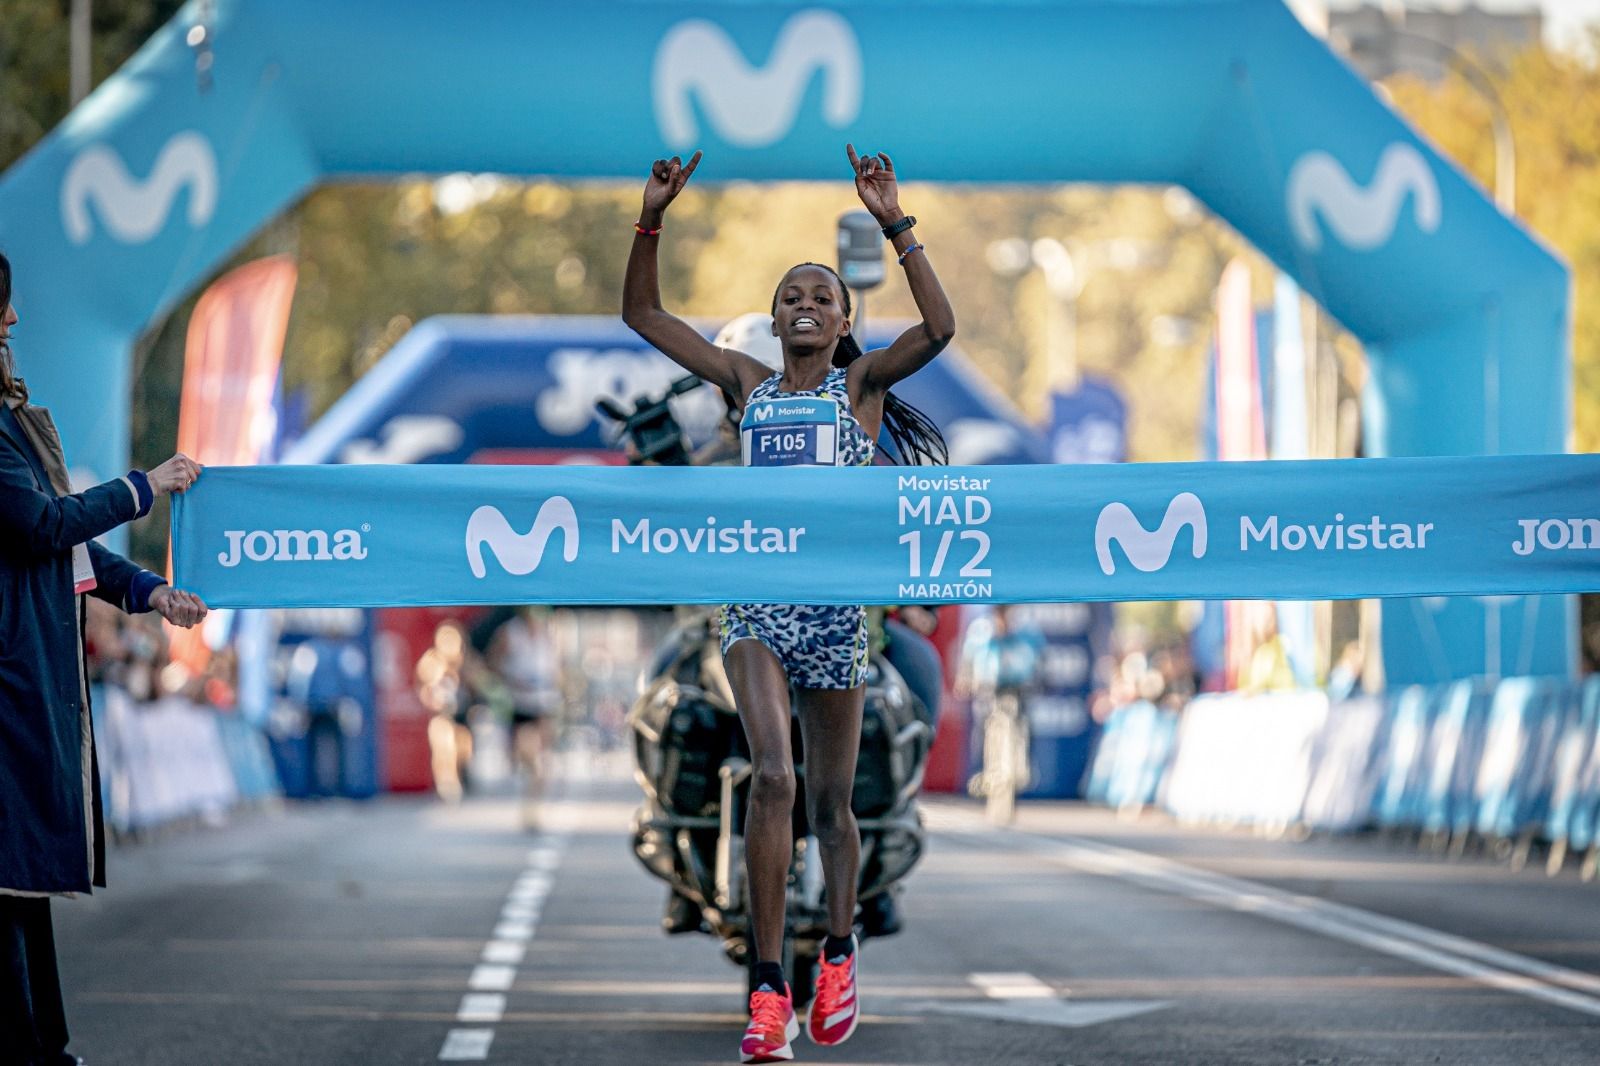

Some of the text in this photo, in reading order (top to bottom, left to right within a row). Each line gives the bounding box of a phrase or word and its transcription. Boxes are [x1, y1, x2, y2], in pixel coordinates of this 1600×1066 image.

[778, 406, 816, 416] Movistar
[760, 432, 806, 453] F105
[898, 475, 991, 491] Movistar
[898, 495, 992, 525] MAD
[611, 516, 806, 553] Movistar
[1240, 513, 1434, 551] Movistar
[1511, 518, 1600, 556] Jom
[898, 529, 992, 577] 1/2
[898, 579, 992, 598] MARATÓN
